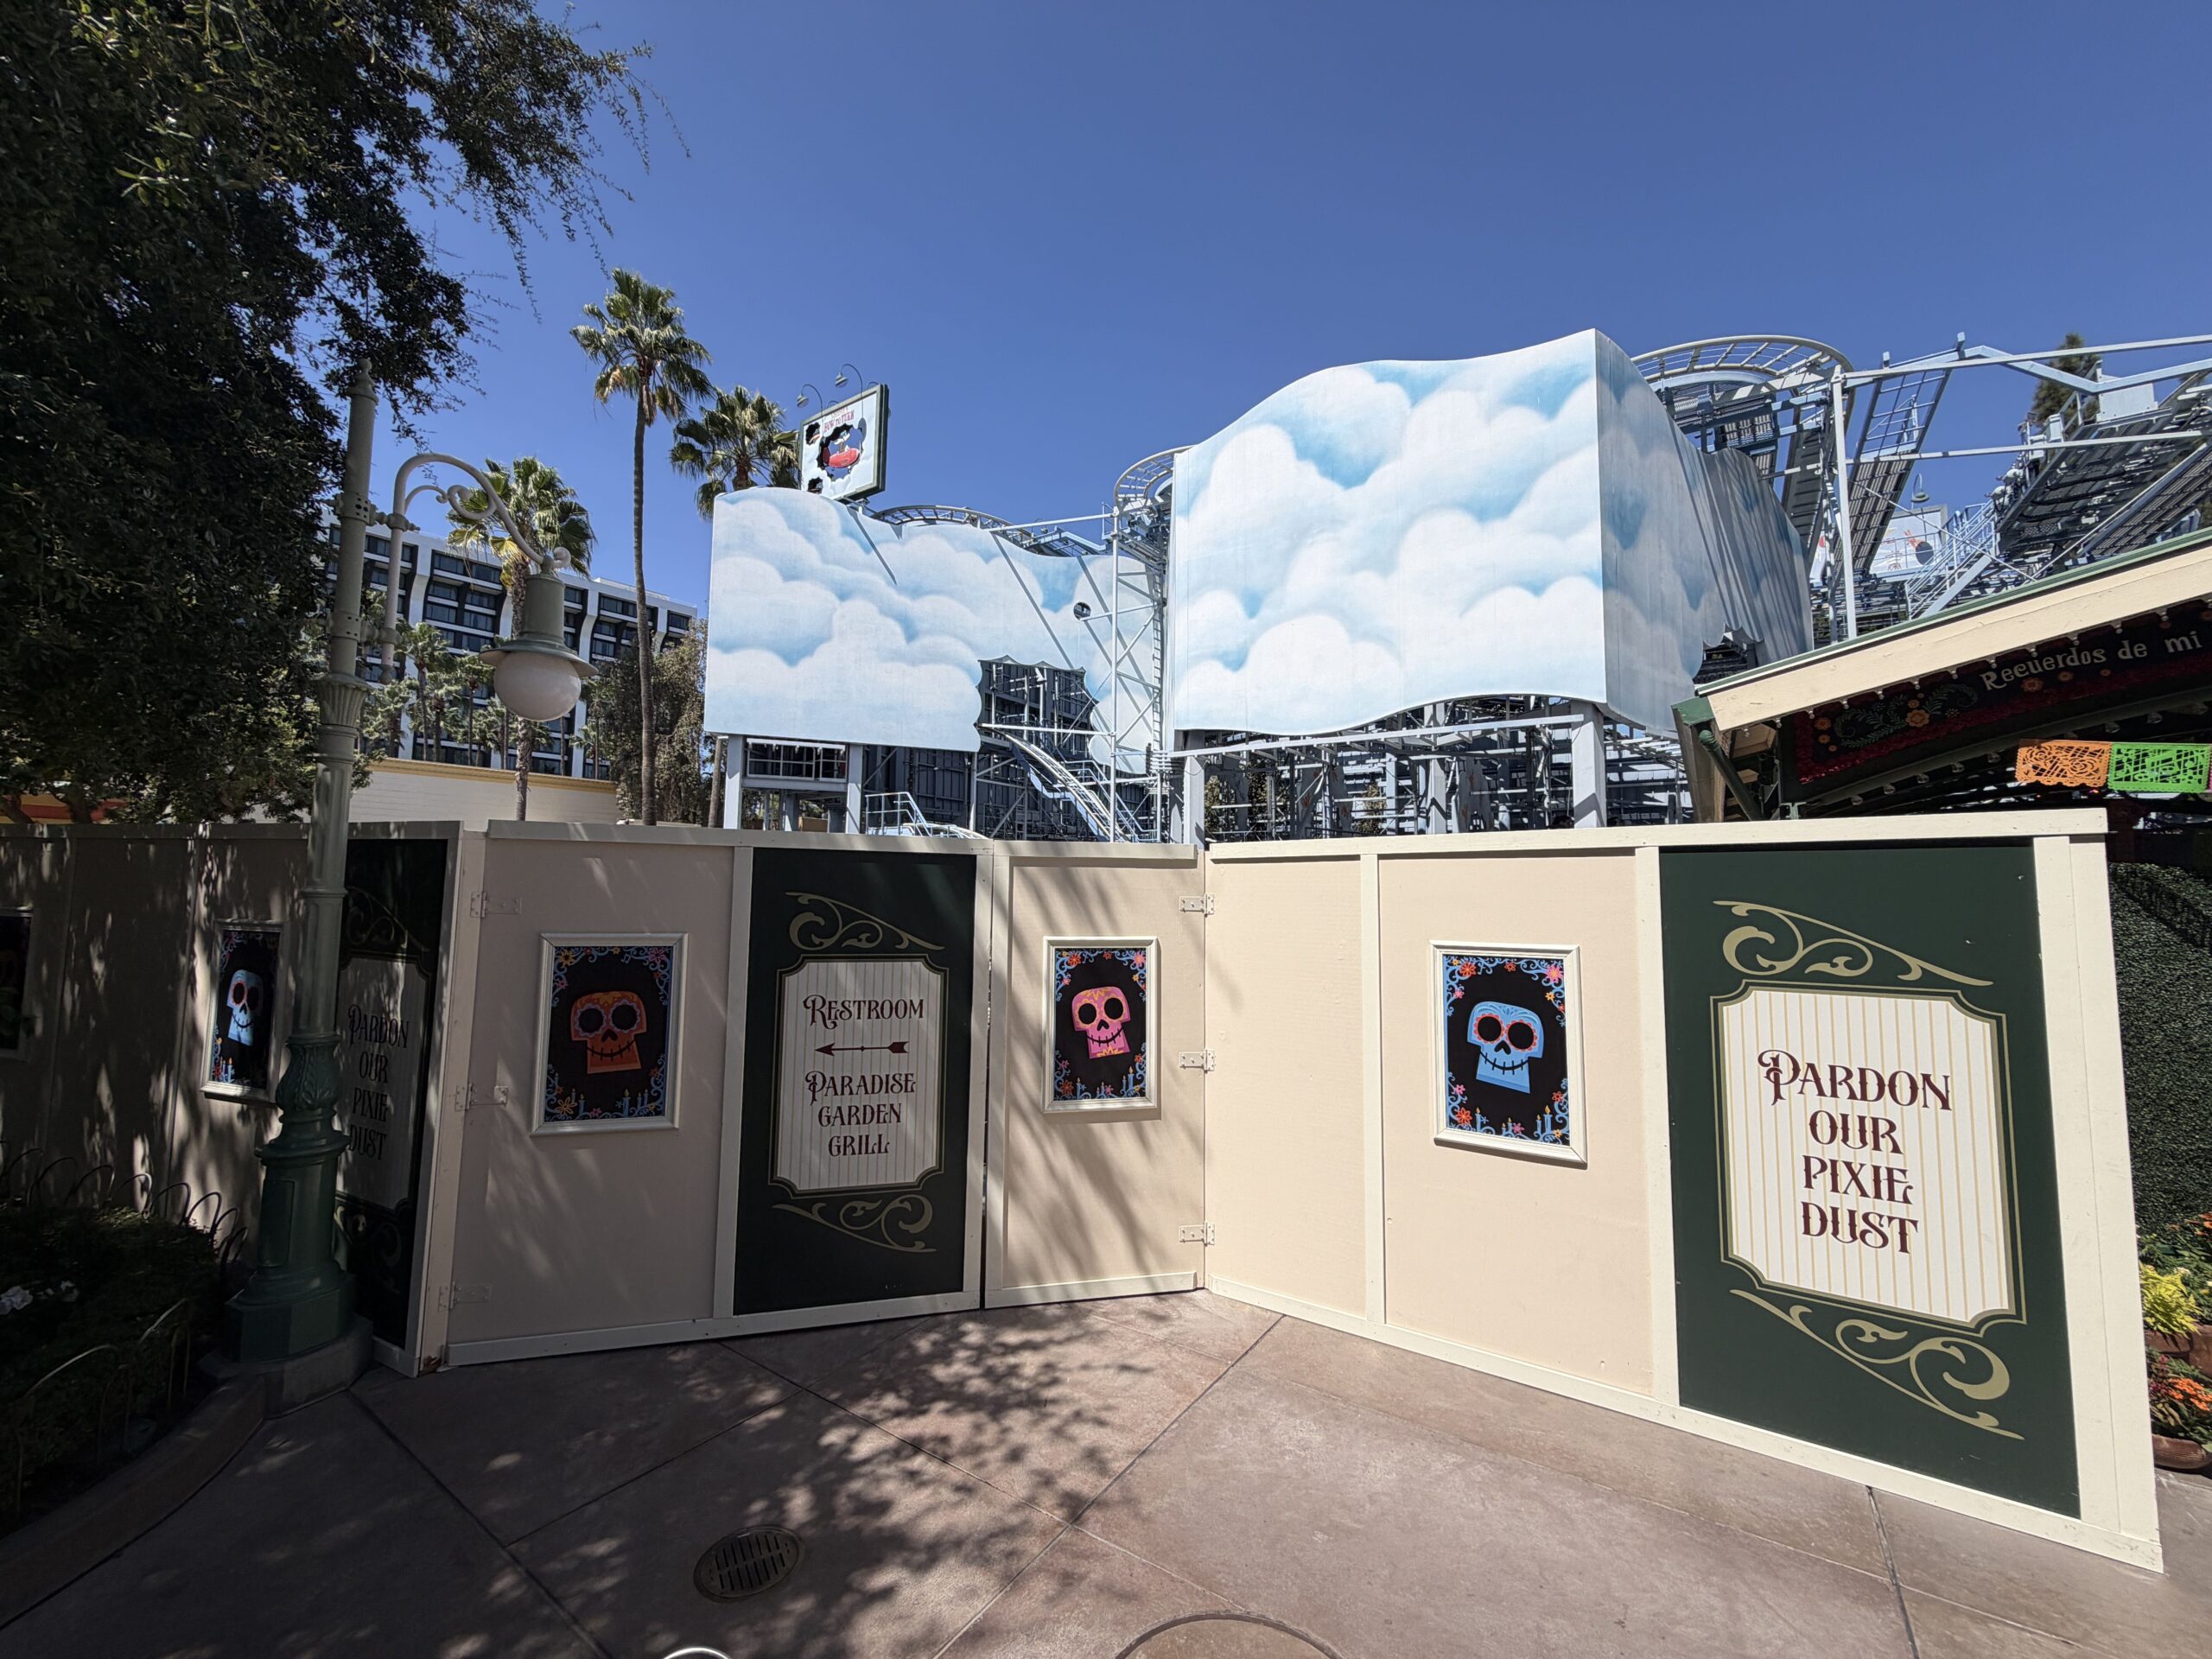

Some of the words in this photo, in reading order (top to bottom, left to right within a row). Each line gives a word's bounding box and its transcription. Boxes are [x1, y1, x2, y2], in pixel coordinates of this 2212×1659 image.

[1980, 646, 2107, 691] Recuerdos
[2118, 640, 2148, 660] de
[2164, 630, 2202, 653] mi
[348, 1004, 410, 1049] PARDON
[802, 995, 924, 1030] RESTROOM
[359, 1051, 388, 1084] OUR
[1758, 1049, 1953, 1111] PARDON
[353, 1087, 388, 1122] PIXIE
[805, 1071, 917, 1106] PARADISE
[817, 1103, 902, 1127] GARDEN
[1808, 1109, 1904, 1154] OUR
[349, 1124, 388, 1160] DUST
[828, 1134, 890, 1157] GRILL
[1802, 1154, 1914, 1205] PIXIE
[1800, 1201, 1919, 1255] DUST
